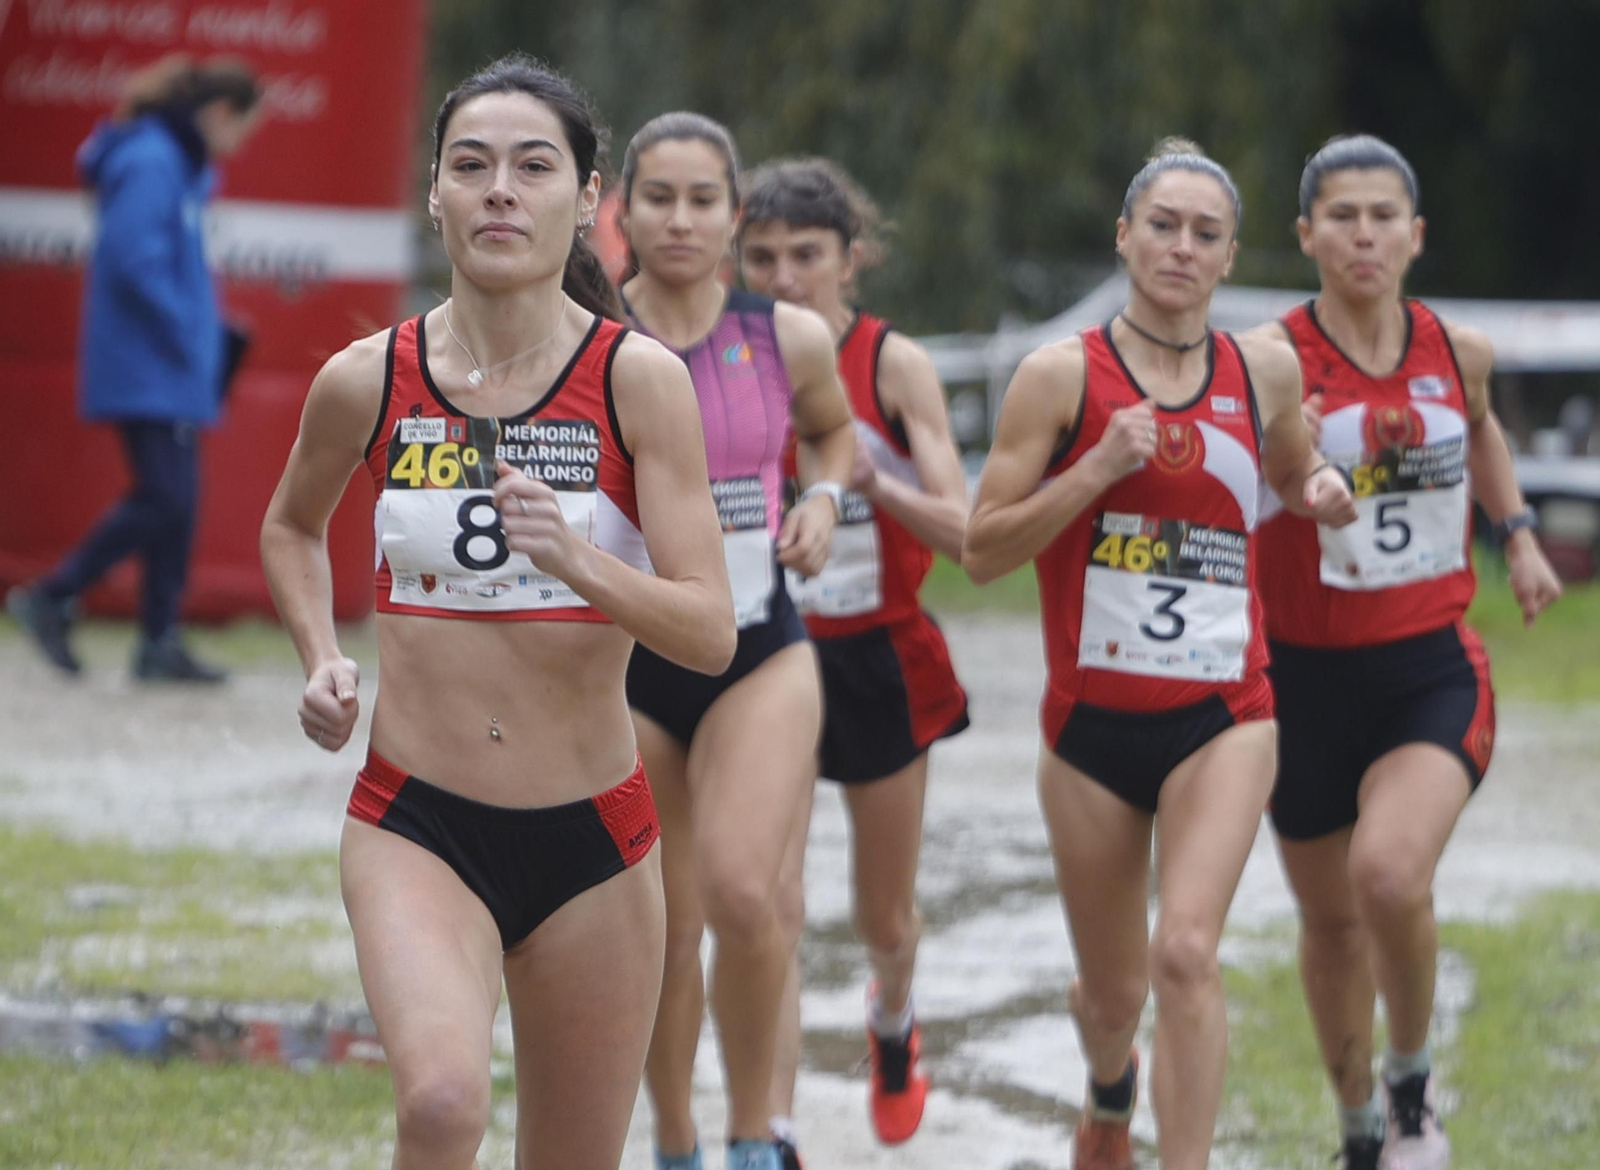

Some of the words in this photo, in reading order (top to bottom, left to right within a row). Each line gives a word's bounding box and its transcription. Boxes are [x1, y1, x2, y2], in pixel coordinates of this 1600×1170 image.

[403, 422, 442, 430] CONCELLO
[504, 424, 599, 444] MEMORIAL
[494, 444, 599, 464] BELARMINO
[523, 463, 595, 483] ALONSO
[453, 494, 510, 571] 8
[1374, 499, 1411, 553] 5
[1138, 581, 1188, 643] 3
